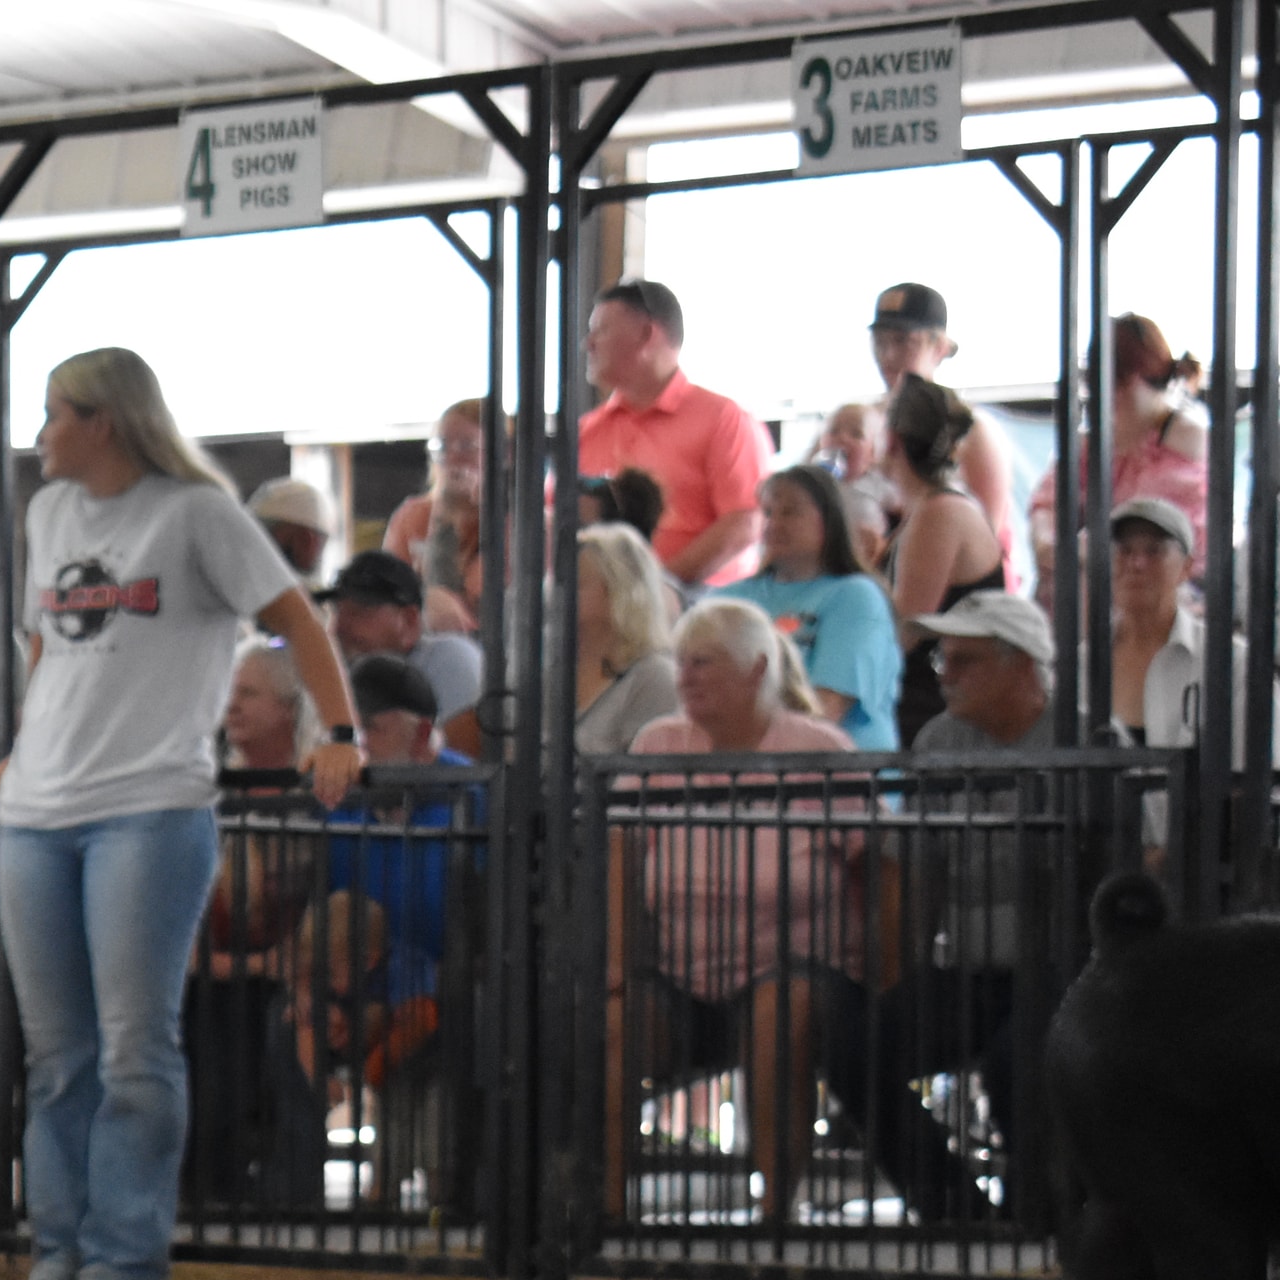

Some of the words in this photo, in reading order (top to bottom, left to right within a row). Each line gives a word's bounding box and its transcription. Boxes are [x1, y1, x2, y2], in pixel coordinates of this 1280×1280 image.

[835, 48, 954, 81] OAKVEIW
[800, 55, 834, 160] 3
[849, 85, 939, 114] FARMS
[211, 117, 317, 149] LENSMAN
[852, 121, 939, 149] MEATS
[186, 127, 216, 218] 4
[231, 152, 297, 179] SHOW
[238, 184, 291, 209] PIGS
